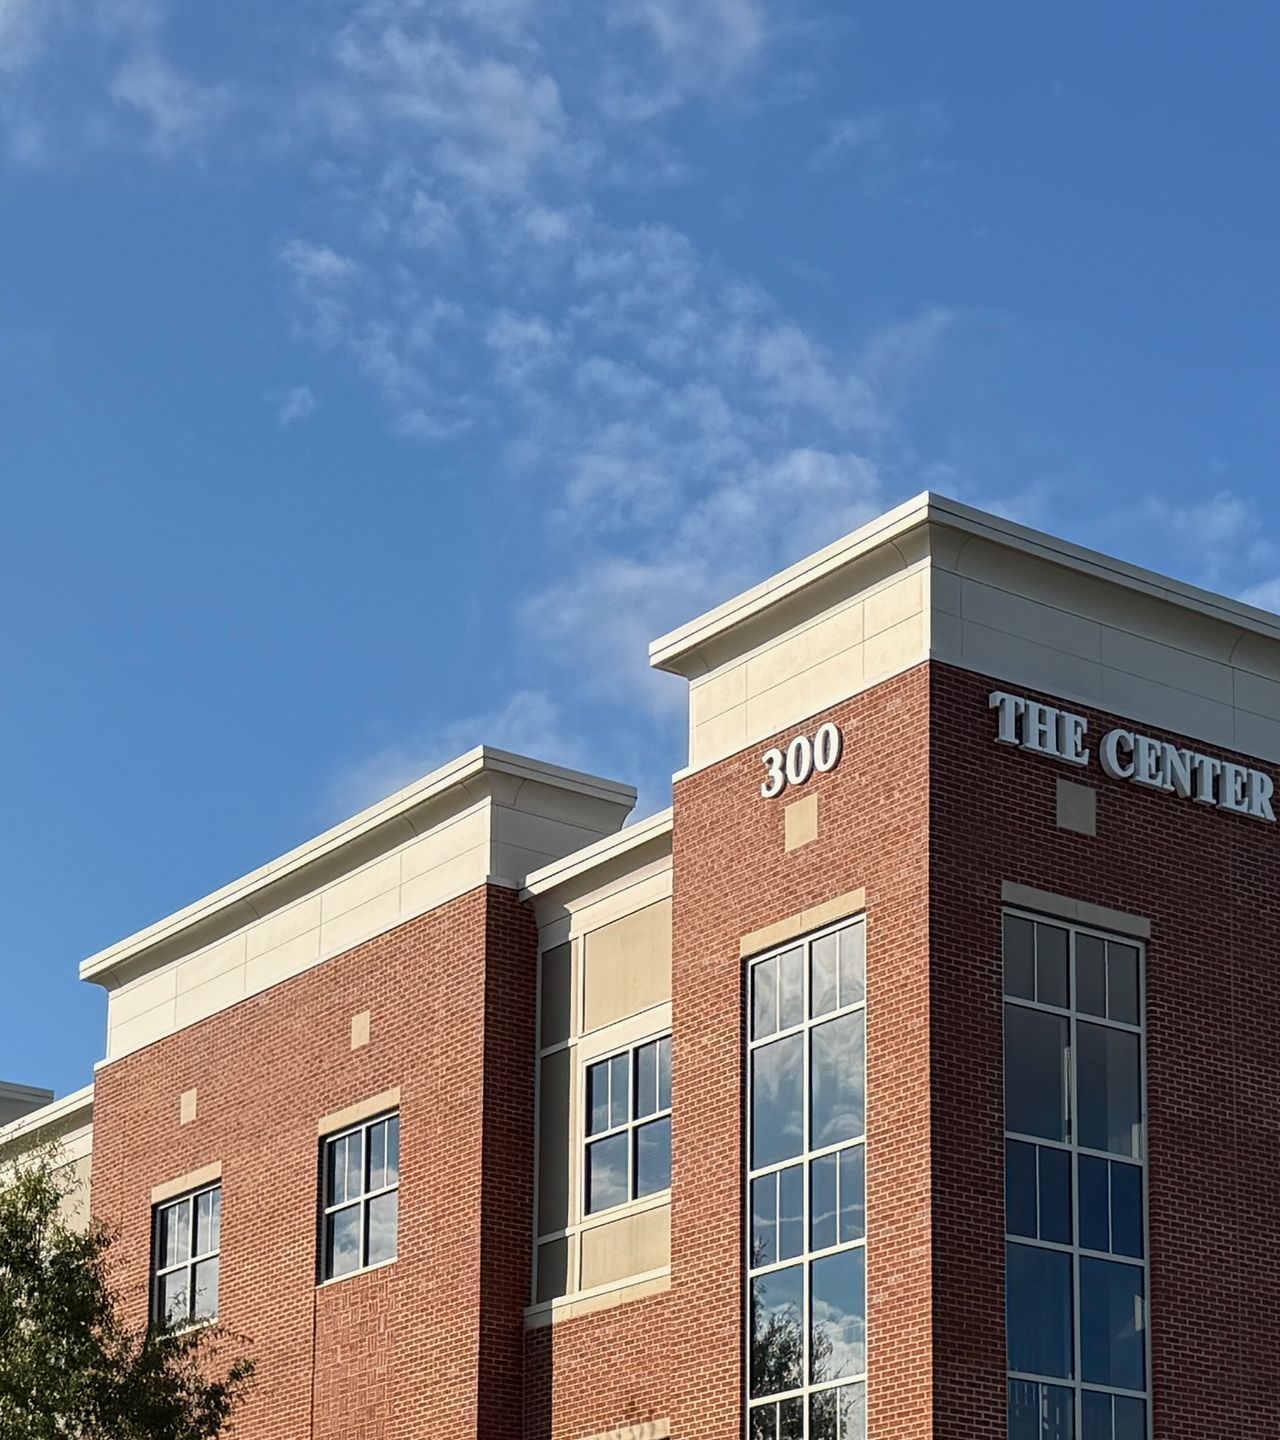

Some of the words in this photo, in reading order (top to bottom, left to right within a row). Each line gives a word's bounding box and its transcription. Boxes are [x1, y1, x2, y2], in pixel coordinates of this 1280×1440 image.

[760, 722, 843, 799] 300
[989, 691, 1089, 767] THE
[1100, 729, 1276, 822] CENTER
